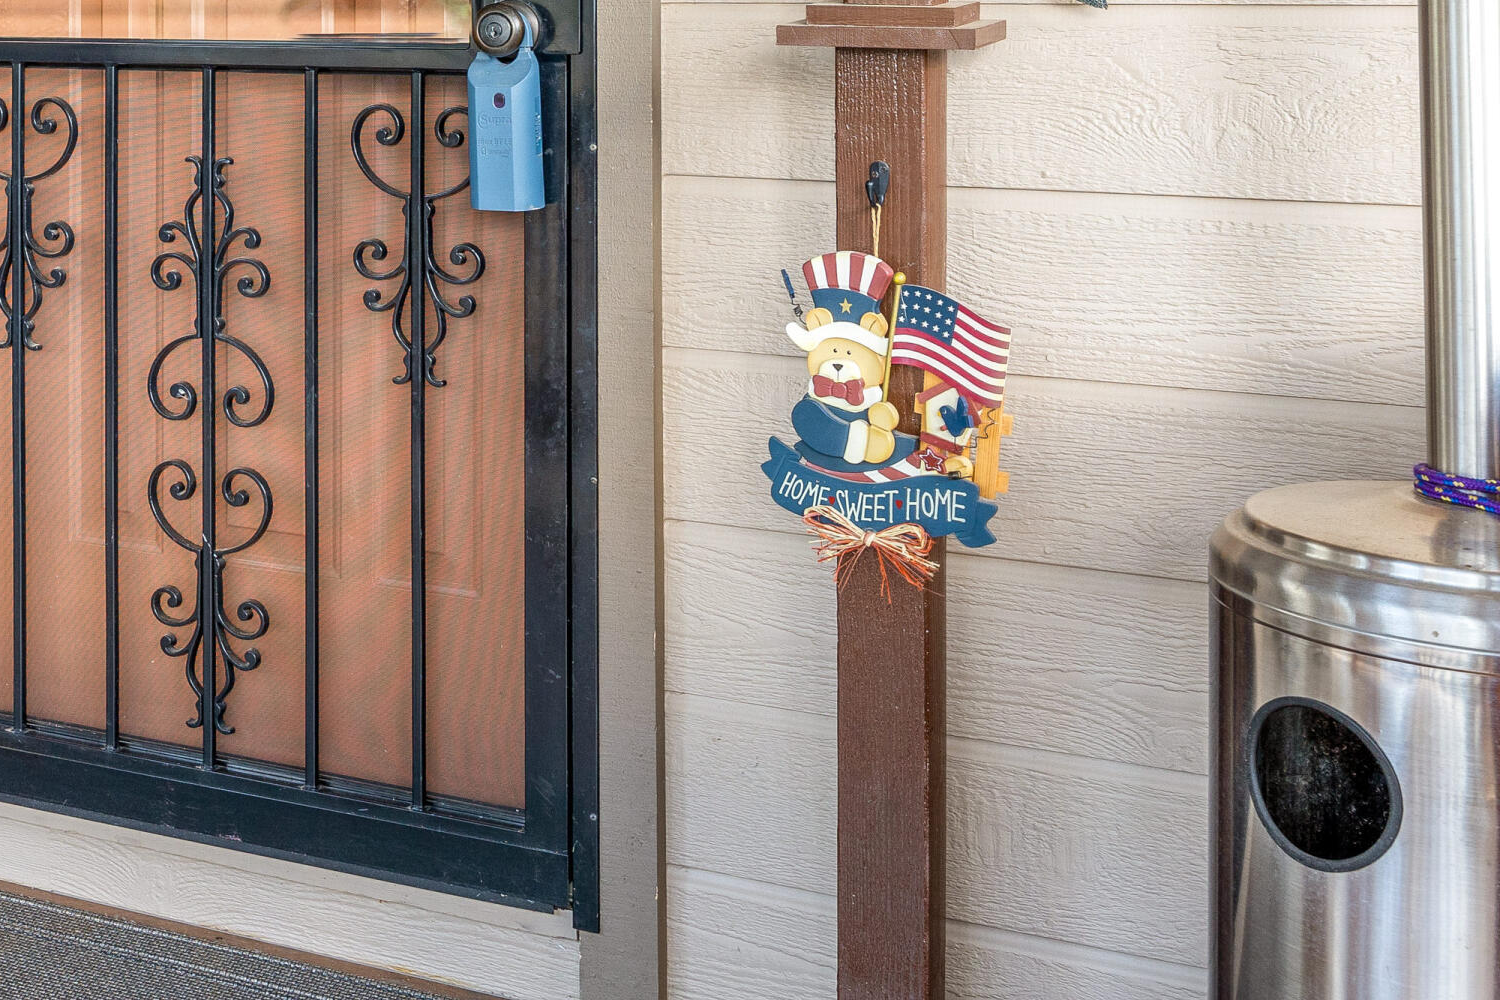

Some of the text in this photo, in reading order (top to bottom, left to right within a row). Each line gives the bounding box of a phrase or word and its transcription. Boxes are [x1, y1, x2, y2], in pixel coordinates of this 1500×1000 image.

[779, 471, 967, 523] HOME SWEET HOME
